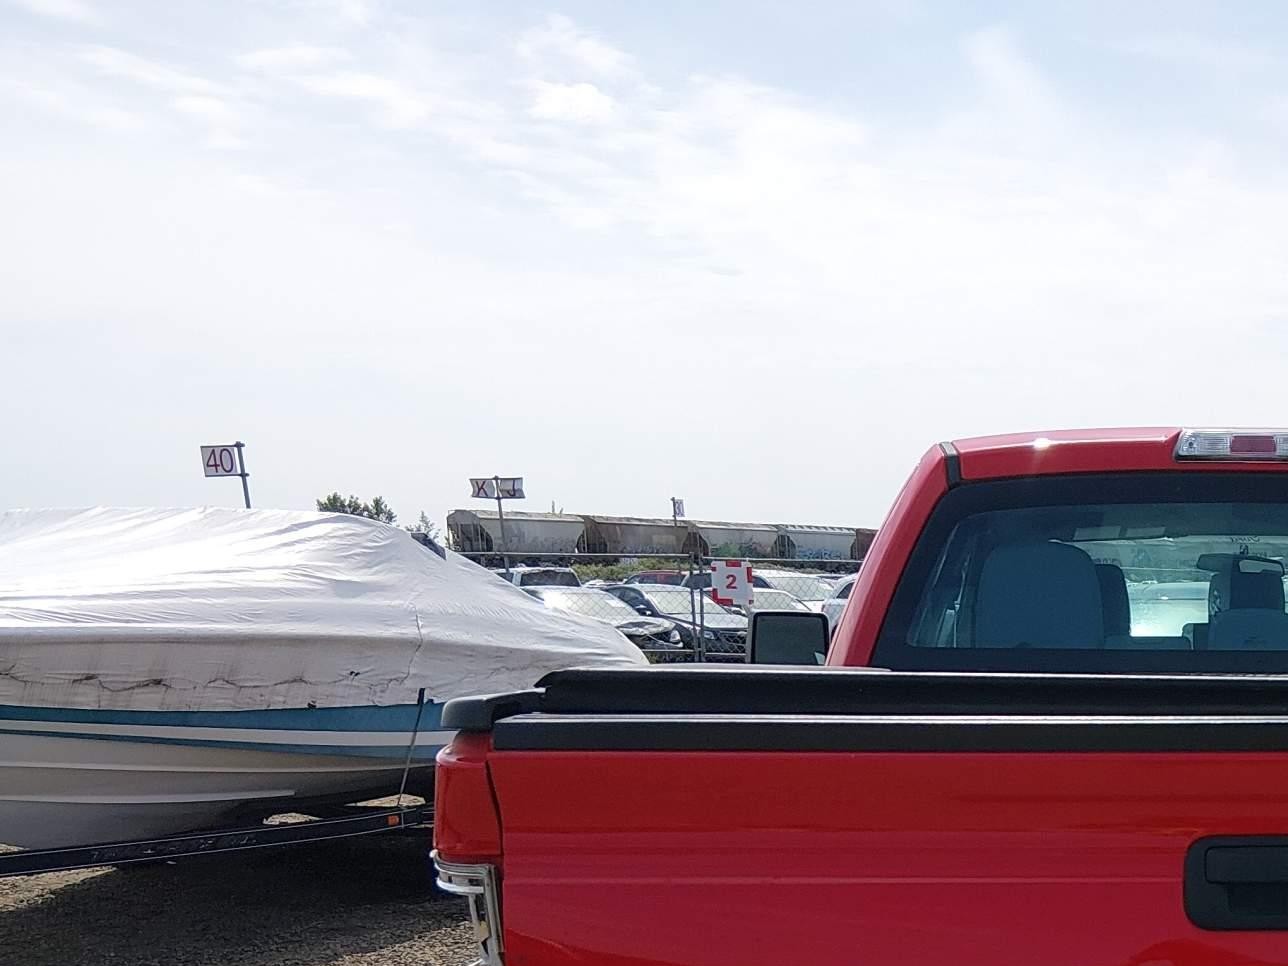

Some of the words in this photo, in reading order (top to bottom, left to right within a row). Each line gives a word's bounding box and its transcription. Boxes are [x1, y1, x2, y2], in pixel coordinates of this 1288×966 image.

[206, 448, 234, 473] 40
[475, 480, 489, 497] K
[726, 574, 738, 589] 2
